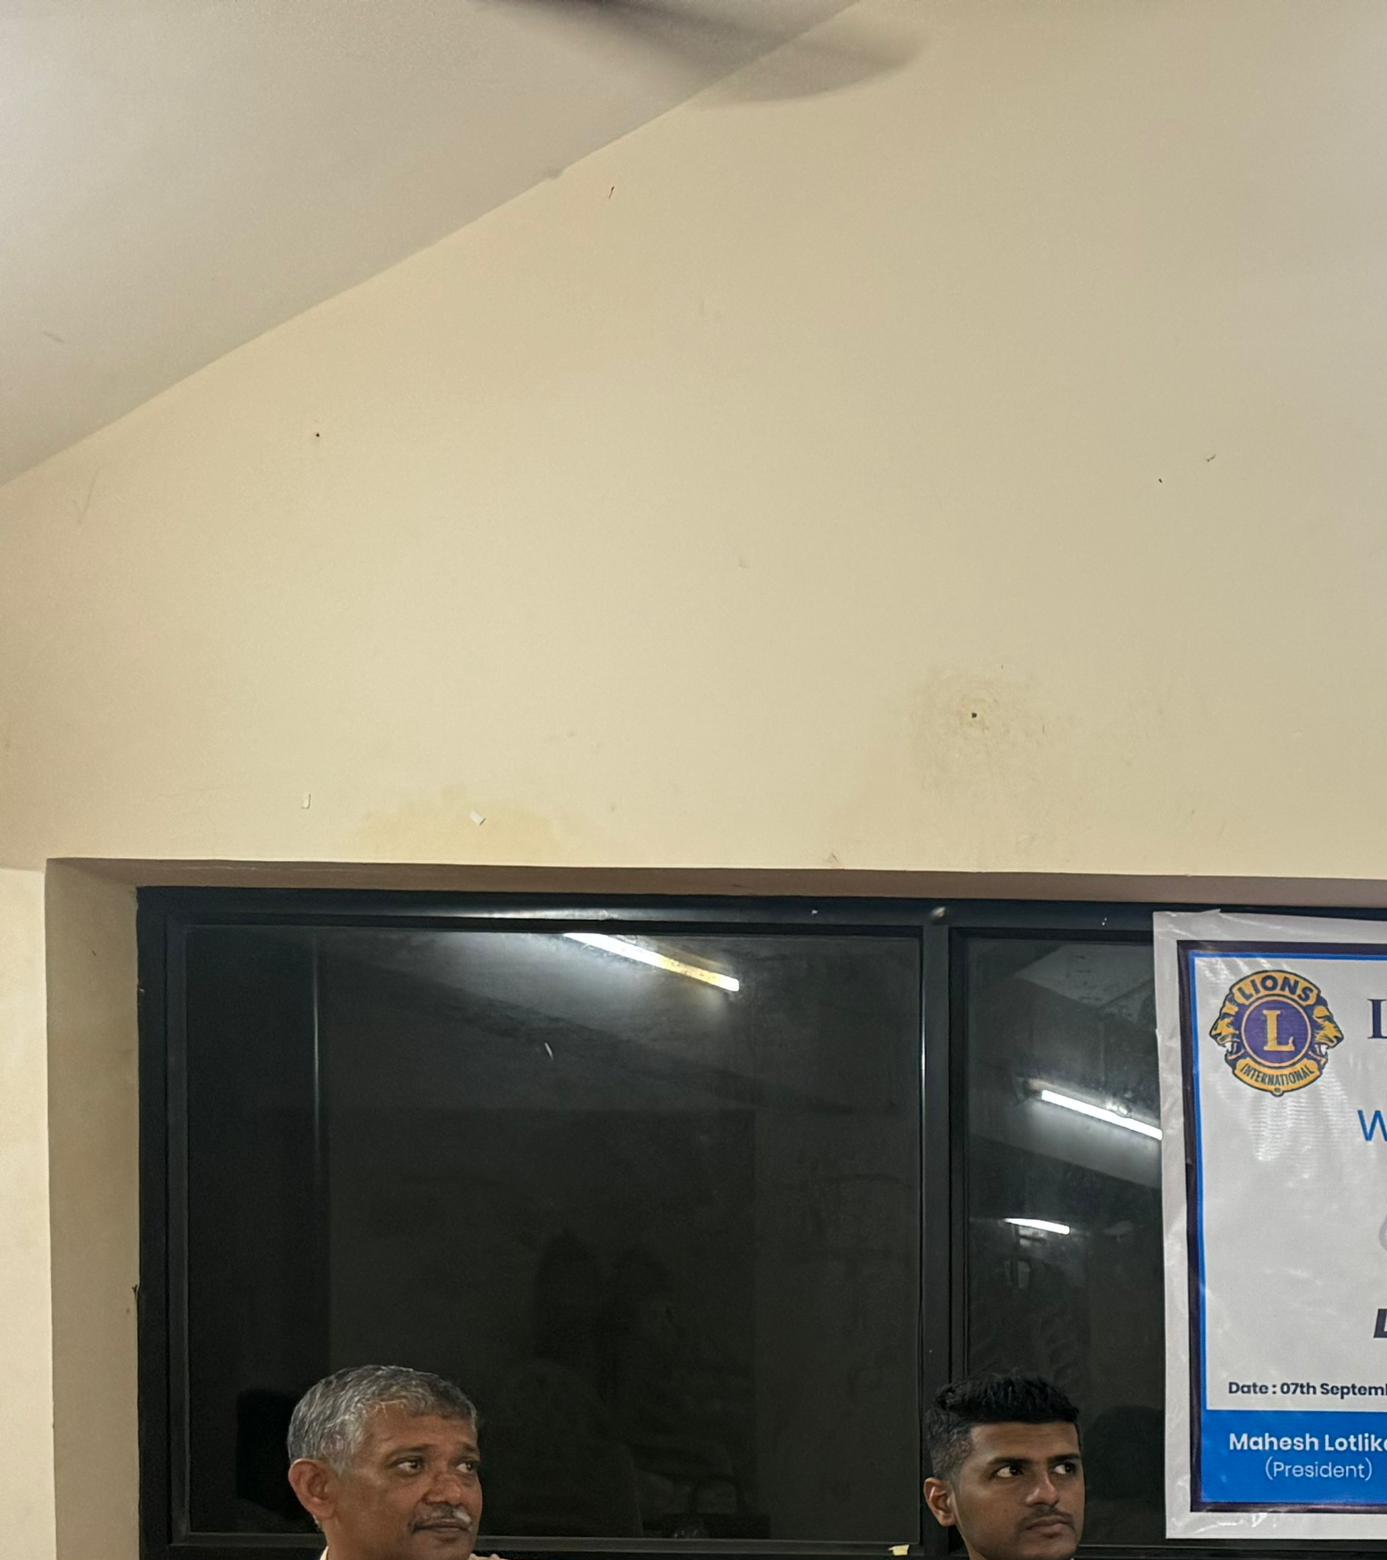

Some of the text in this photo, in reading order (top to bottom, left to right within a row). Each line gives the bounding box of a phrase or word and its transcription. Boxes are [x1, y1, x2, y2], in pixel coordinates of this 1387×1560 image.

[1237, 975, 1314, 1002] LIONS
[1262, 1009, 1295, 1052] L
[1240, 1063, 1315, 1087] INTERNATIONAL
[1228, 1381, 1270, 1395] Date
[1280, 1382, 1317, 1396] 07th
[1229, 1432, 1320, 1451] Mahesh
[1265, 1456, 1374, 1480] (President)
